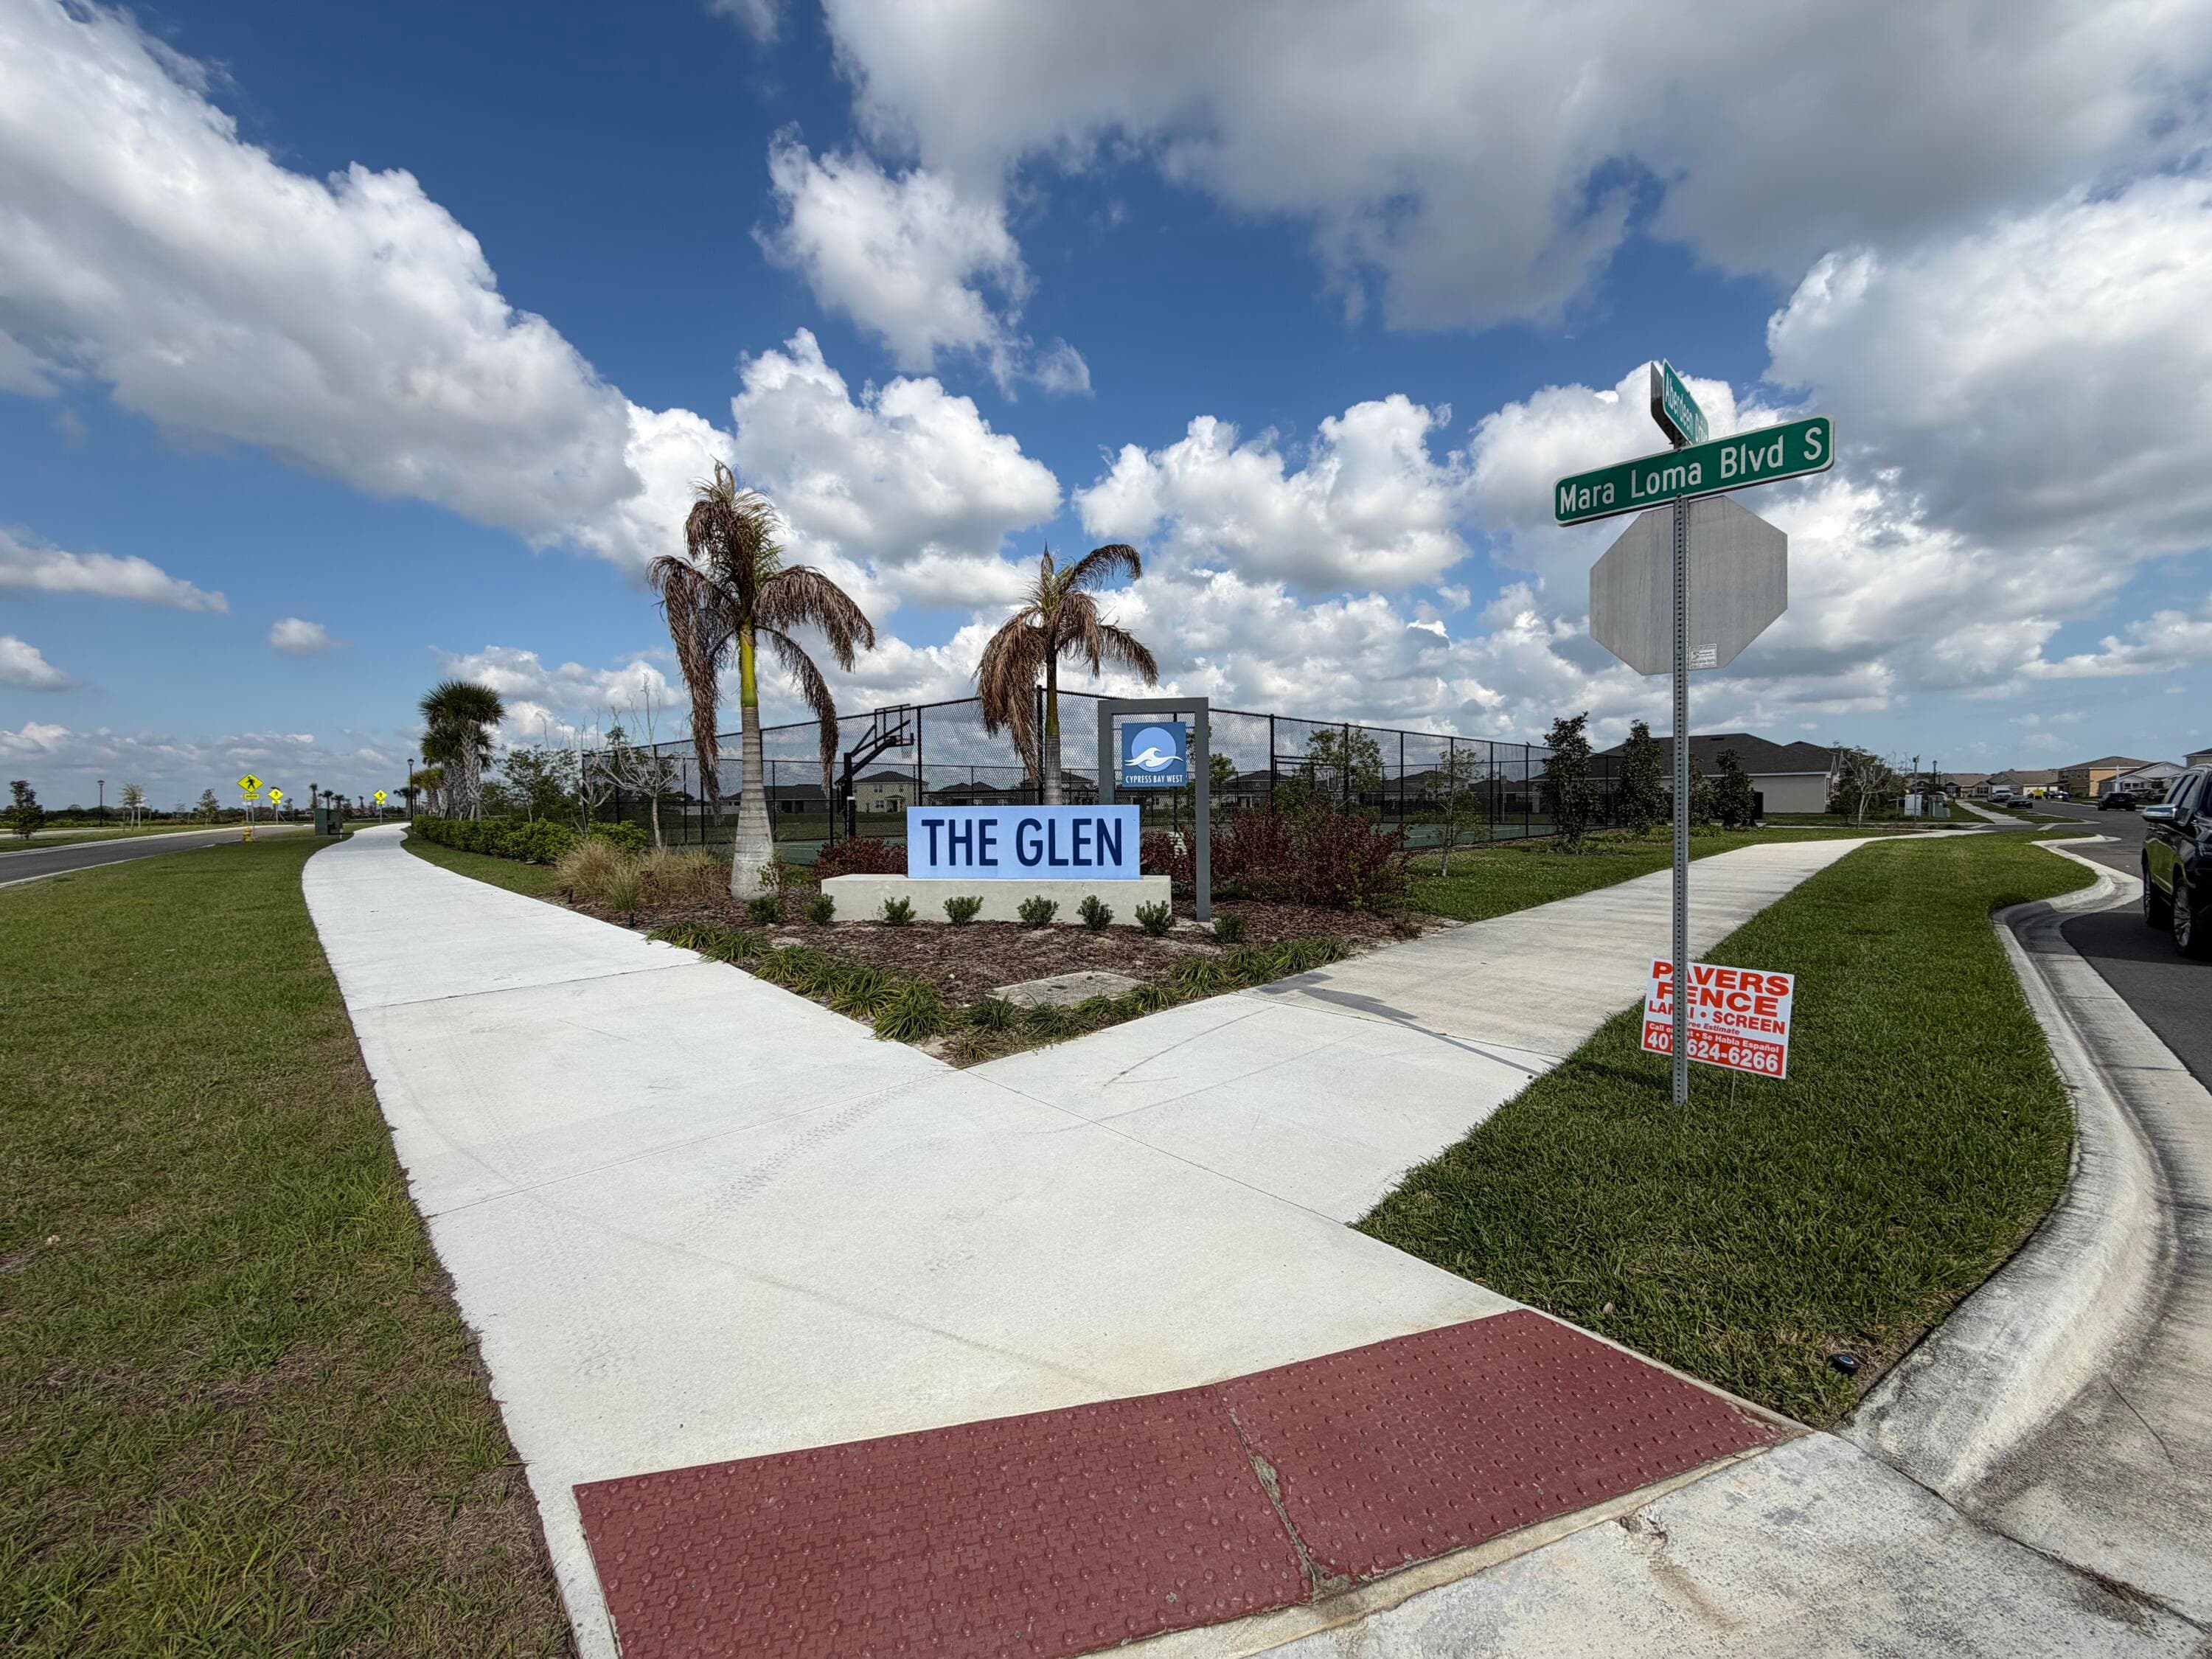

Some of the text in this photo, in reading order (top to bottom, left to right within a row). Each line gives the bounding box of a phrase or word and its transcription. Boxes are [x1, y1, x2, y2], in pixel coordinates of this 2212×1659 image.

[1666, 372, 1708, 442] Aberdeen Driv
[1559, 426, 1823, 515] Mara Loma Blvd S
[1125, 774, 1183, 784] CYPRESS BAY WEST
[921, 818, 1122, 866] THE GLEN
[1649, 1000, 1785, 1034] LAI SCREEN
[1703, 1023, 1740, 1034] Estimate
[1649, 1023, 1664, 1031] Call
[1702, 1032, 1713, 1040] Se
[1715, 1034, 1740, 1046] Habla
[1742, 1040, 1779, 1053] Español
